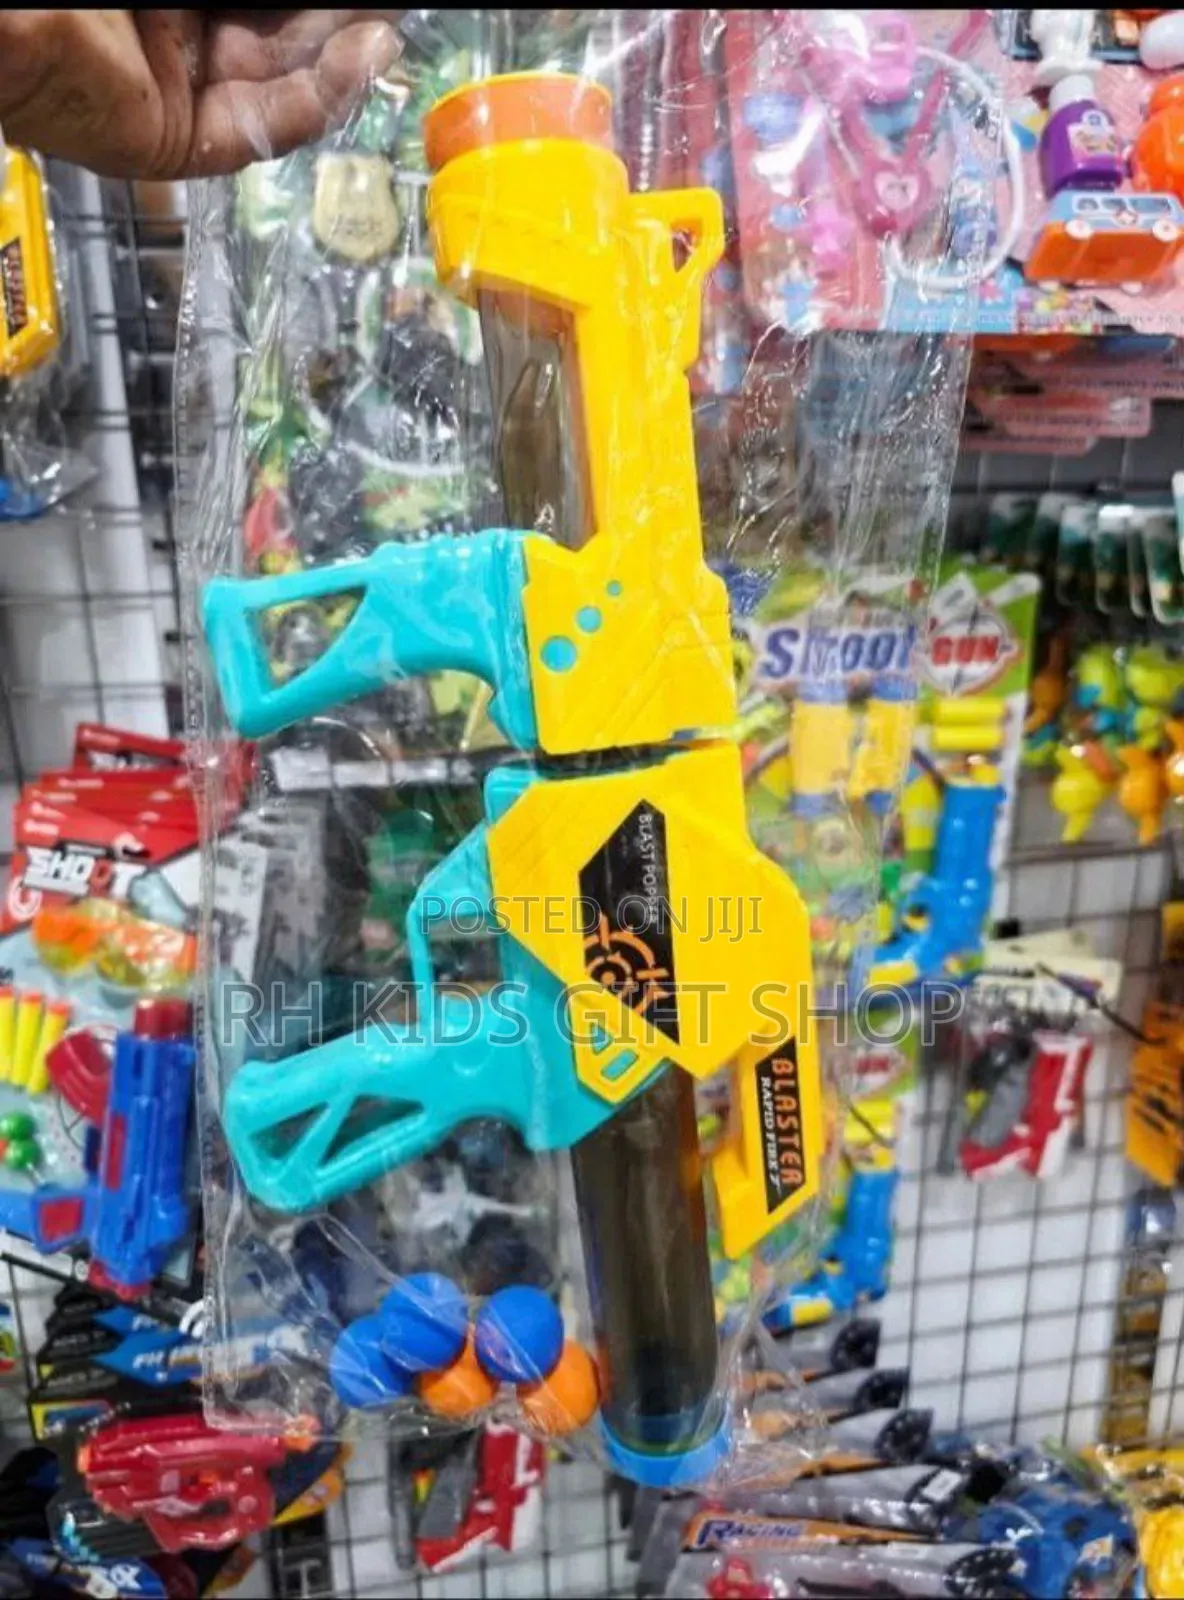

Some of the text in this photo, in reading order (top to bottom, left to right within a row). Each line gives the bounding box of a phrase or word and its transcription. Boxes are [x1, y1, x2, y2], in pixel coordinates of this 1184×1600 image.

[931, 634, 1000, 667] GUN
[639, 814, 655, 859] BLAST
[761, 1076, 775, 1128] RAPID
[771, 1057, 804, 1185] BLASTER
